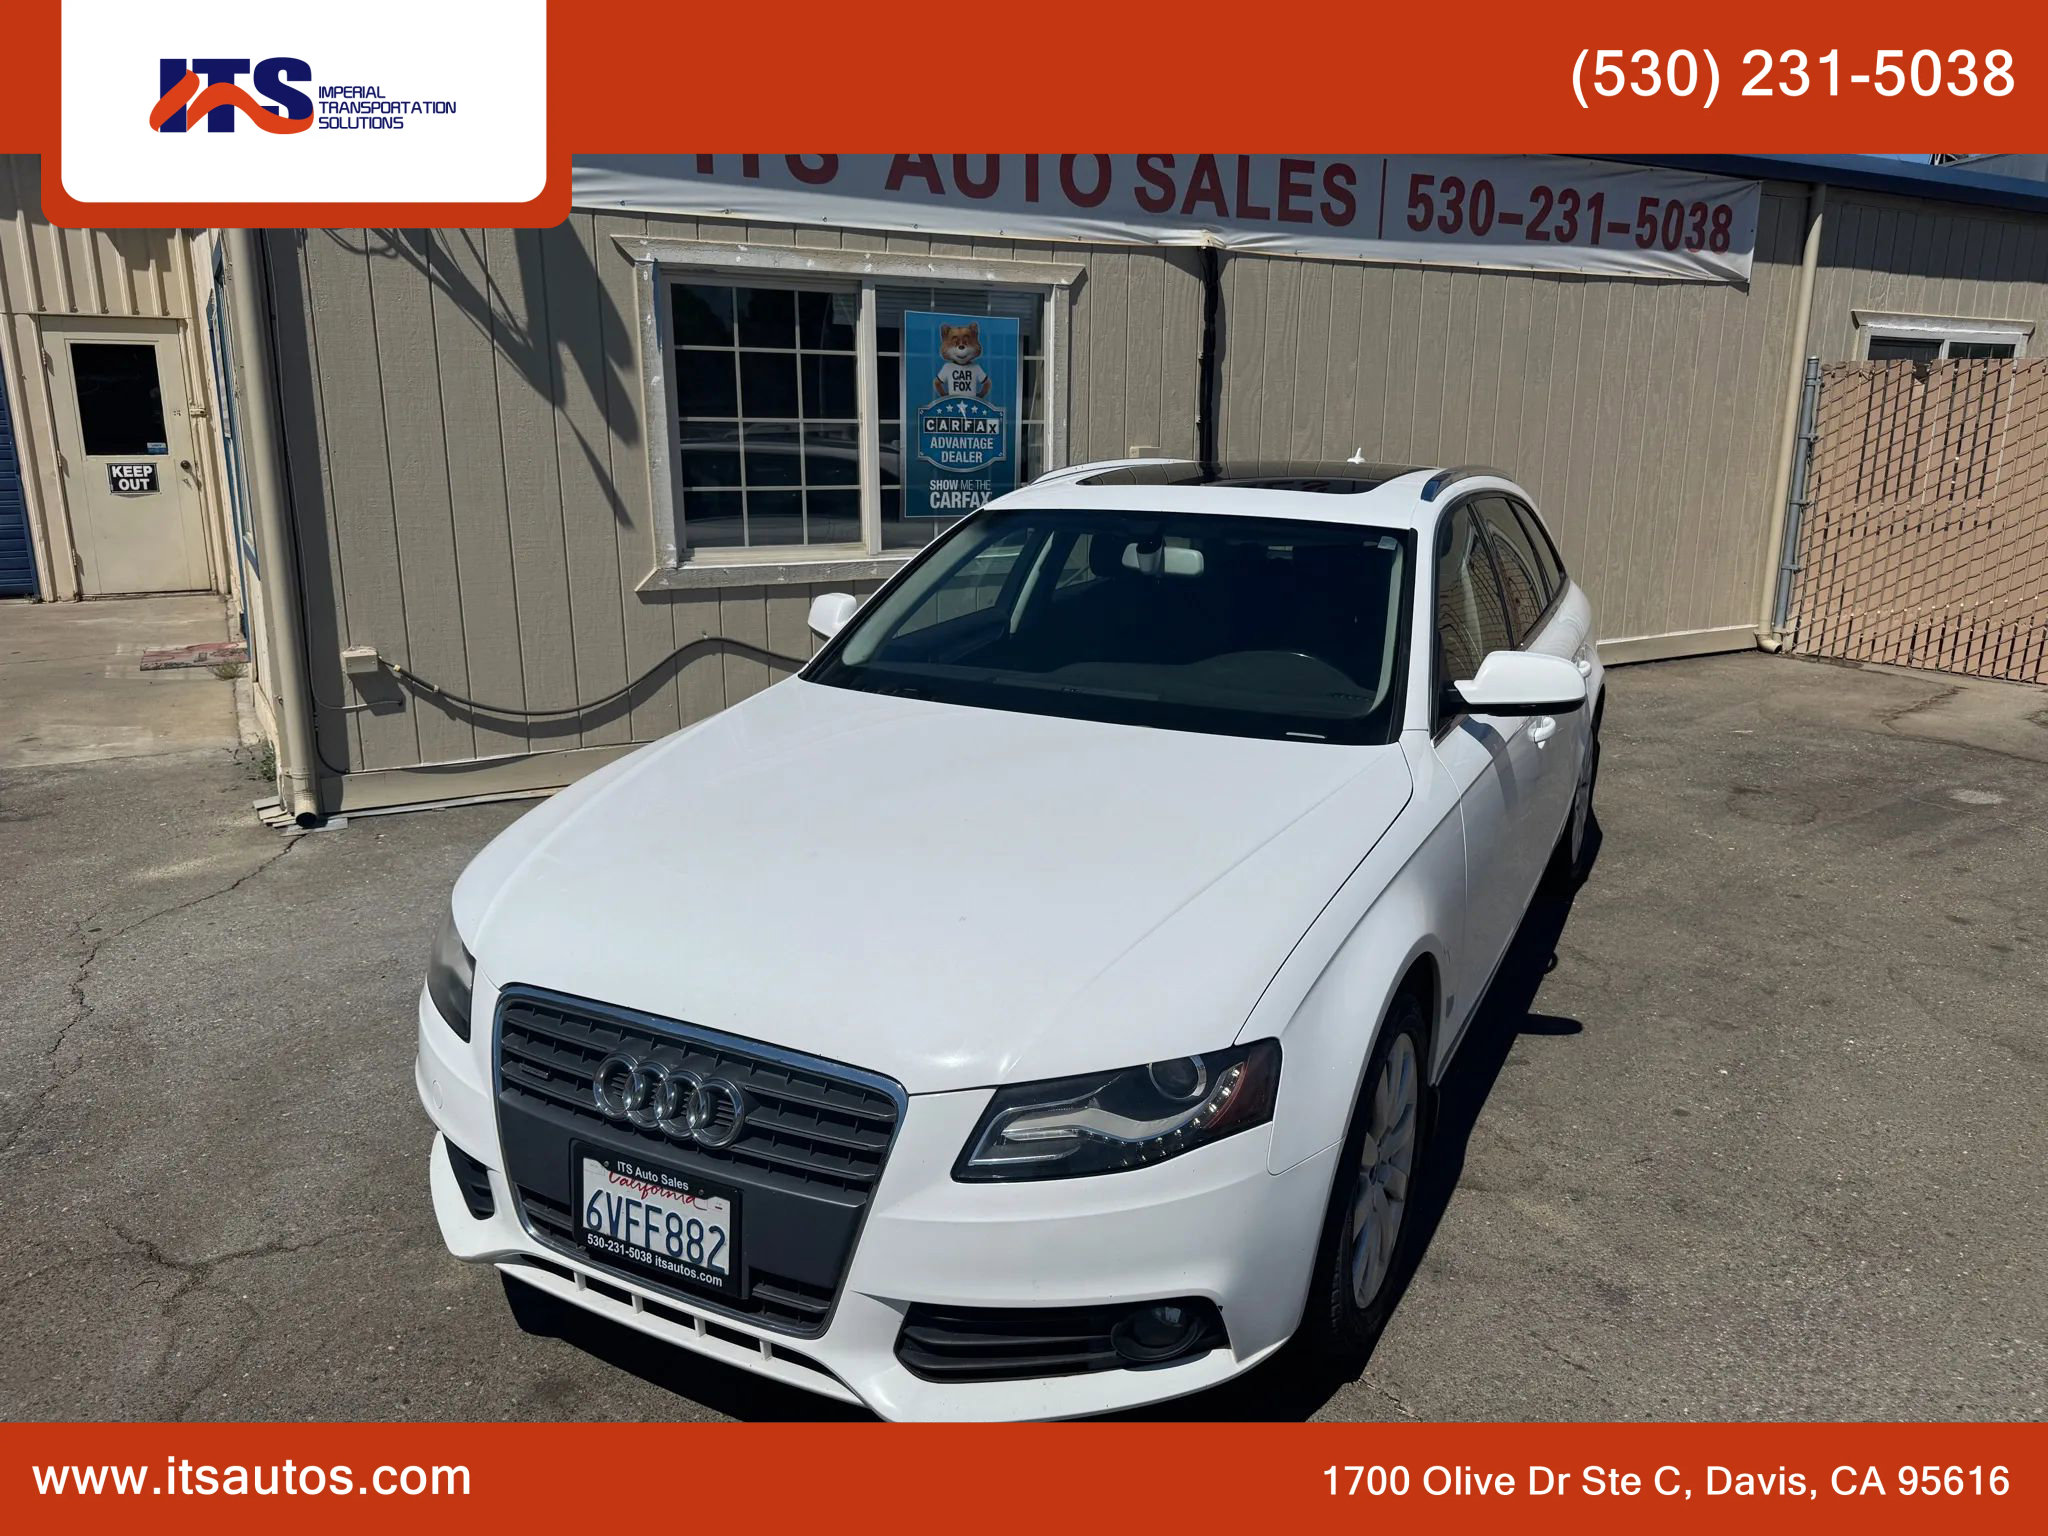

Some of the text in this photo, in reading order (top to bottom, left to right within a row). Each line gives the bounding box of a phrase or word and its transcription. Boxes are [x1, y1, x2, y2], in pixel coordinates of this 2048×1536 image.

[1134, 154, 1357, 227] SALES
[1407, 173, 1733, 254] 530-231-5038
[952, 370, 972, 381] CAR
[953, 381, 972, 392] FOX
[925, 419, 998, 434] CARFAX
[930, 437, 994, 450] ADVANTAGE
[941, 450, 983, 464] DEALER
[111, 465, 153, 478] KEEP
[118, 479, 150, 491] OUT
[929, 479, 991, 491] SHOW ME THE
[929, 491, 990, 509] CARFAX
[617, 1160, 633, 1175] ITS
[635, 1167, 659, 1183] Auto
[661, 1173, 689, 1191] Sales
[586, 1189, 727, 1276] 6VFF882
[587, 1233, 723, 1287] 530-231-5038 itsautos.com
